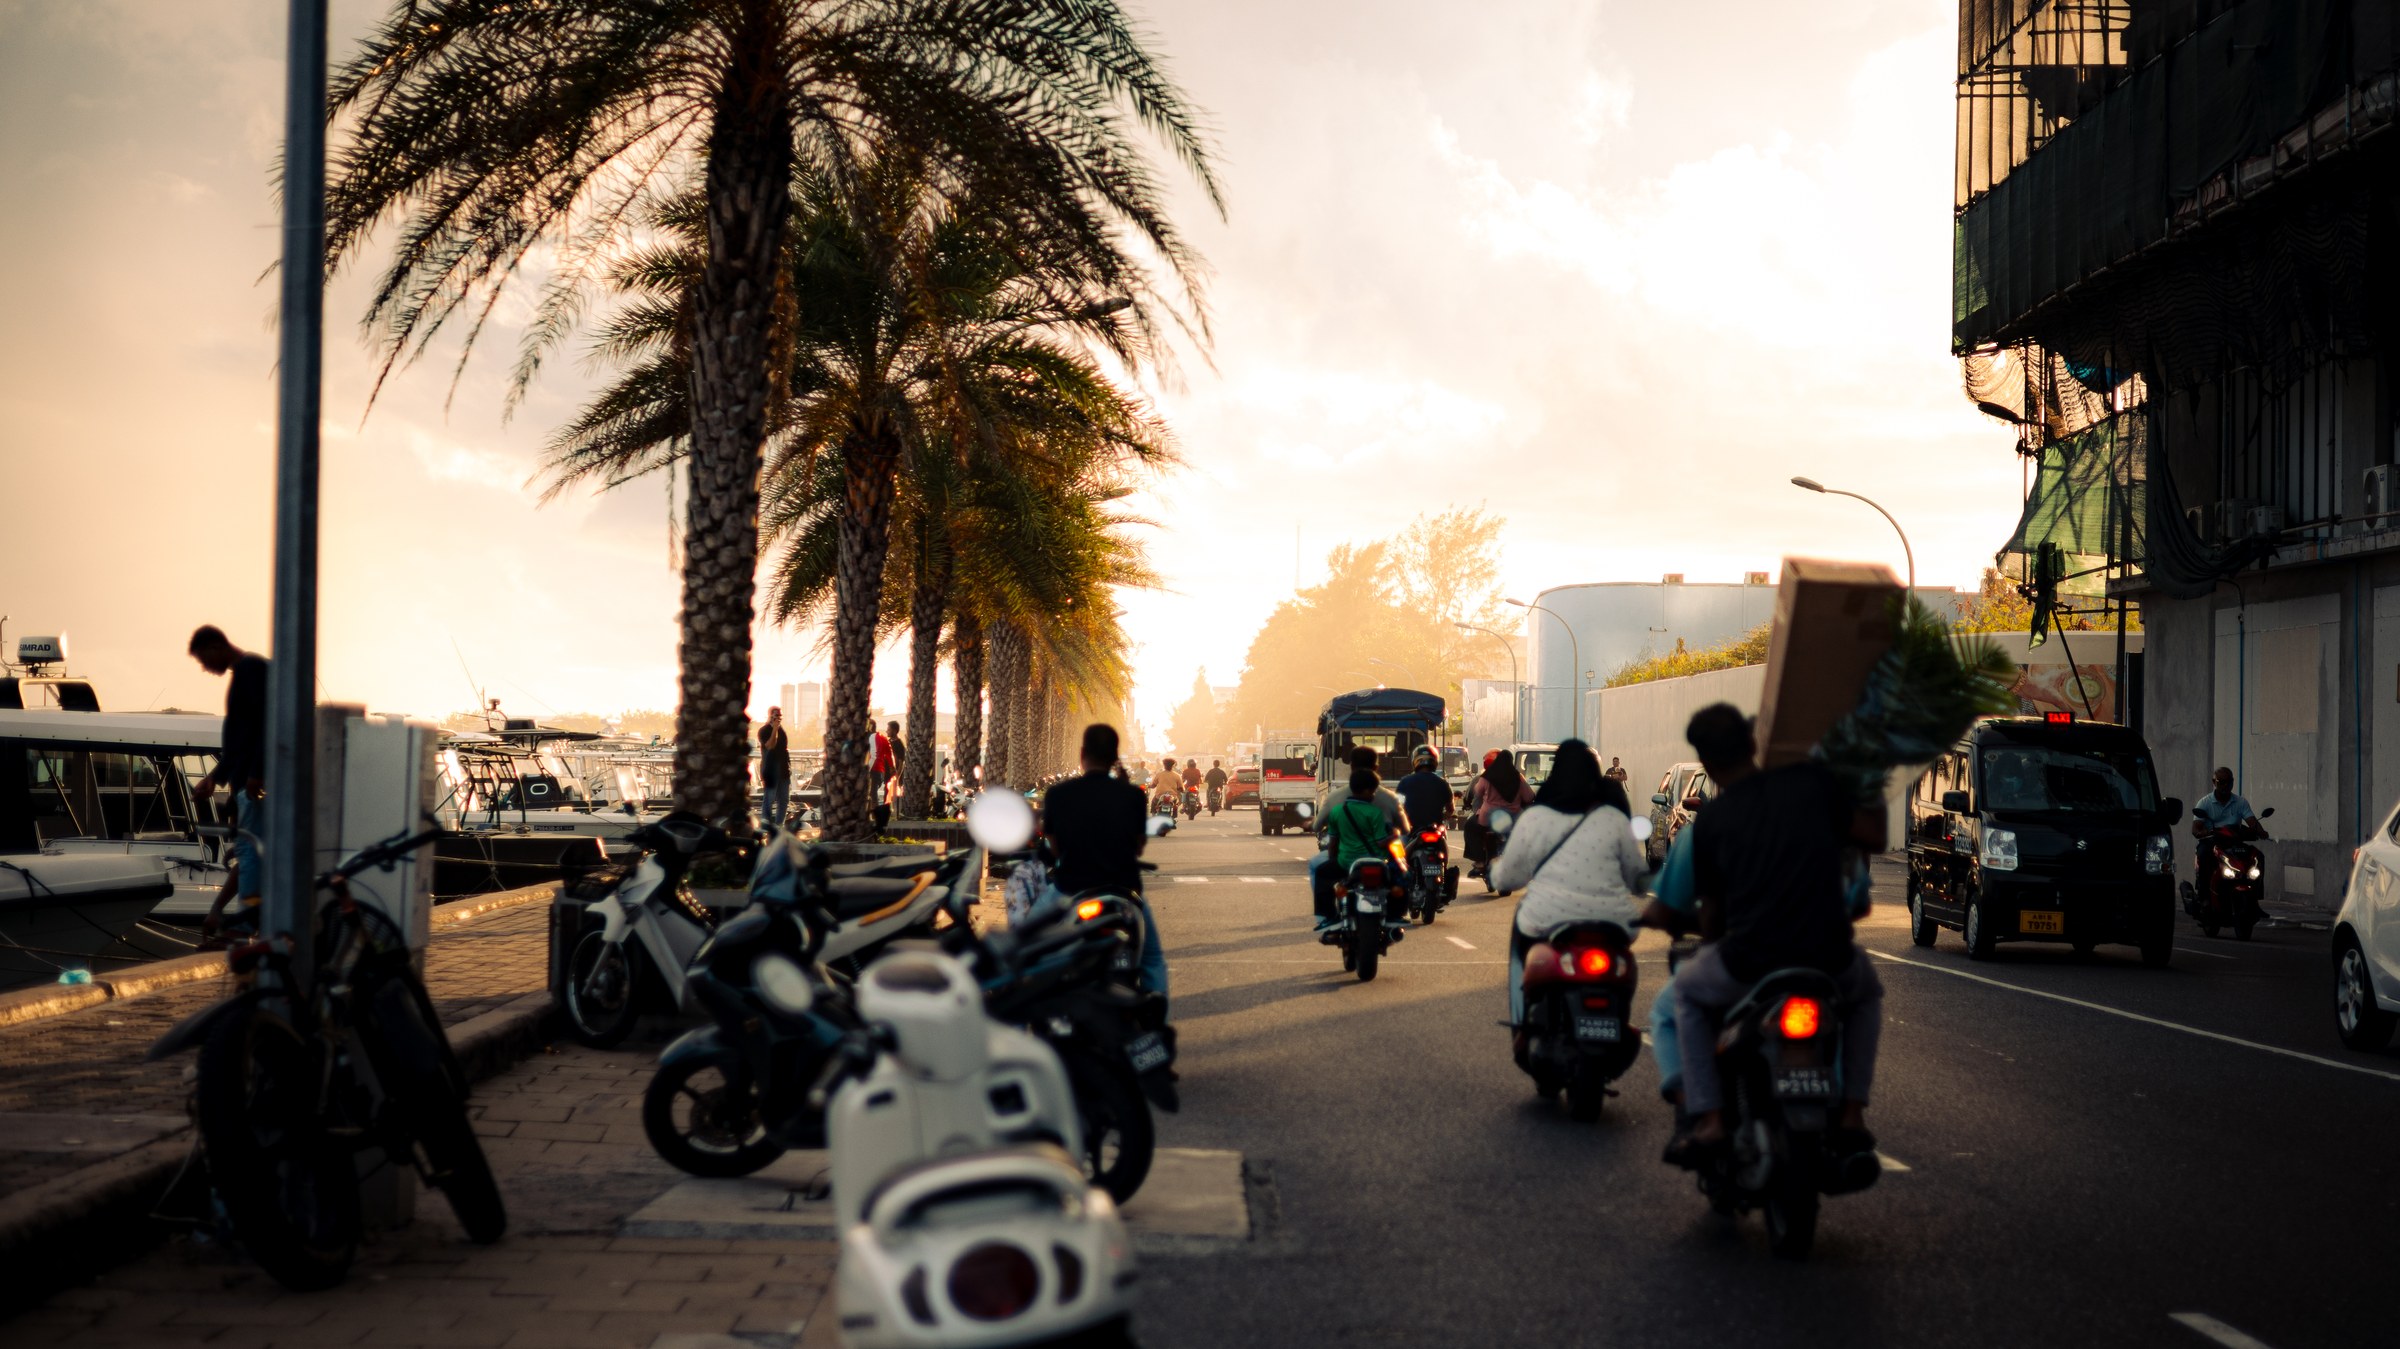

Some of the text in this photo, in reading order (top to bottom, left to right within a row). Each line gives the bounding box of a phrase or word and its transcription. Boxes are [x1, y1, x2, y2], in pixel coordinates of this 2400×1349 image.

[19, 643, 51, 652] SIMRAD
[2048, 712, 2071, 723] TAXI
[2028, 921, 2057, 930] T9751
[1777, 1079, 1831, 1095] P2151
